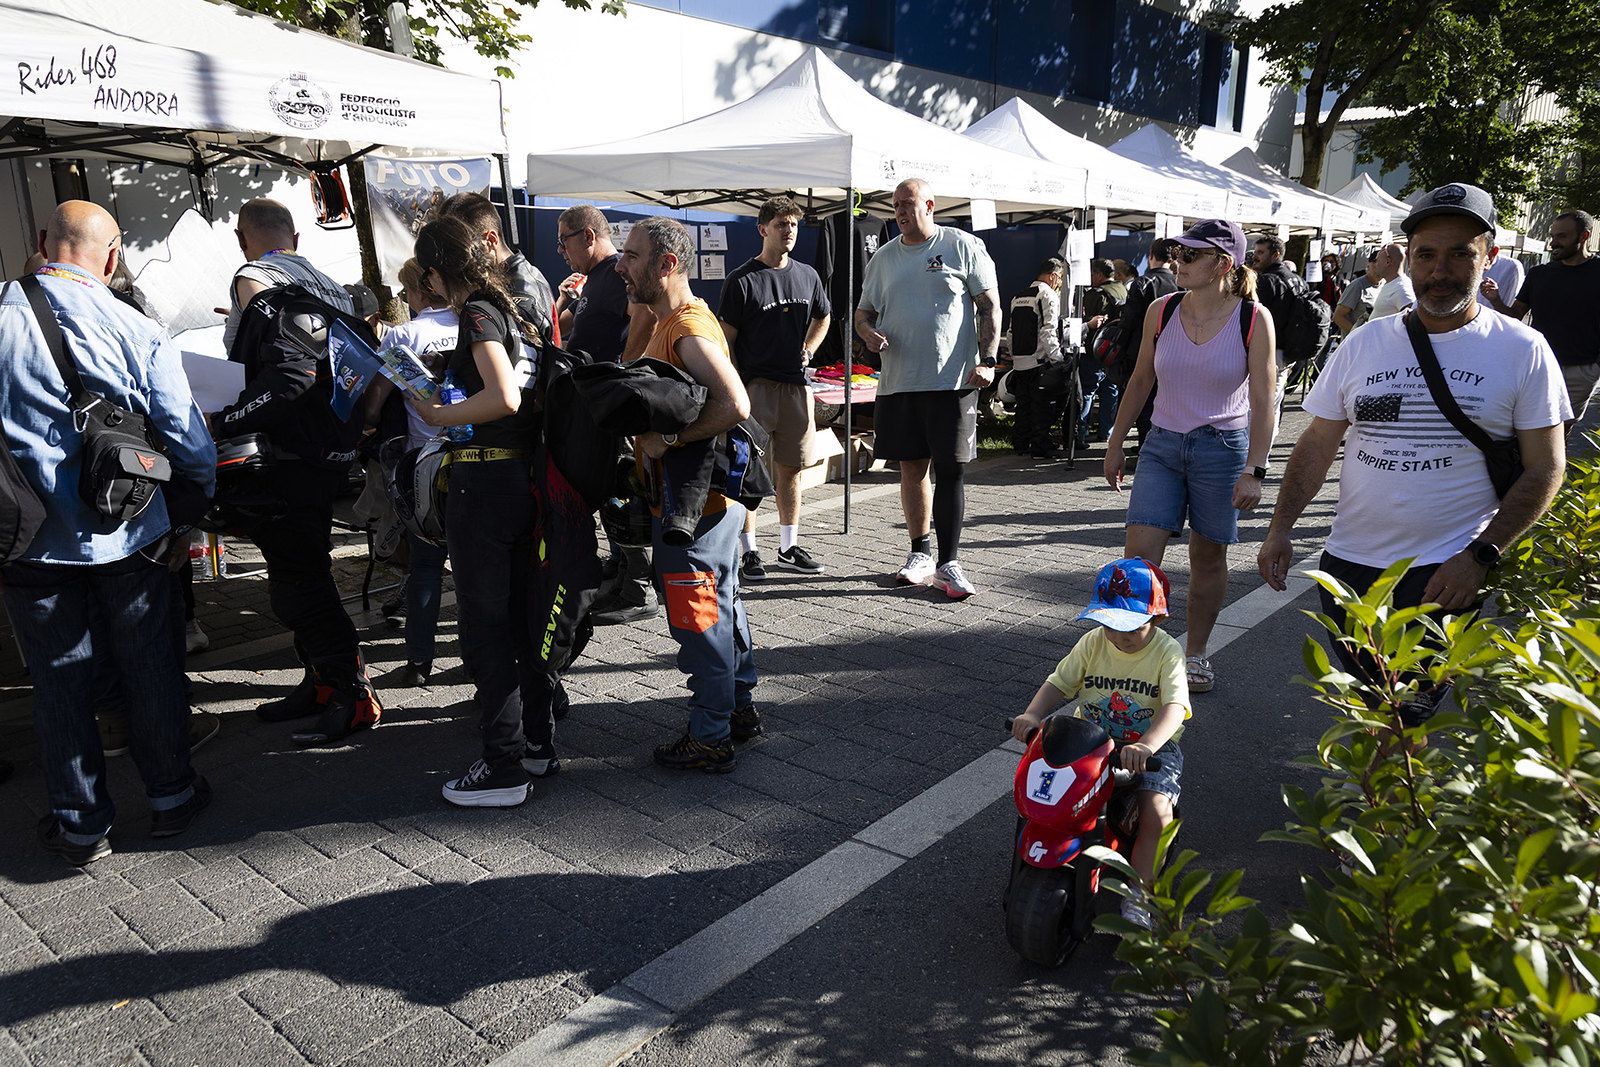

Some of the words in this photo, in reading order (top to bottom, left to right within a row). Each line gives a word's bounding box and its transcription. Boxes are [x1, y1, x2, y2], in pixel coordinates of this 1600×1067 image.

[18, 56, 76, 95] Rider
[82, 45, 117, 83] 468
[94, 85, 178, 116] ANDORRA
[341, 103, 416, 119] MOTOCICLISTA
[376, 159, 471, 188] FOTO
[1366, 369, 1399, 386] NEW
[1405, 366, 1446, 378] YO
[1450, 369, 1485, 387] CITY
[1356, 449, 1399, 472] EMPIRE
[1400, 455, 1453, 472] STATE
[1382, 448, 1400, 457] SINCE
[1033, 770, 1058, 802] 1
[1028, 840, 1049, 863] GT
